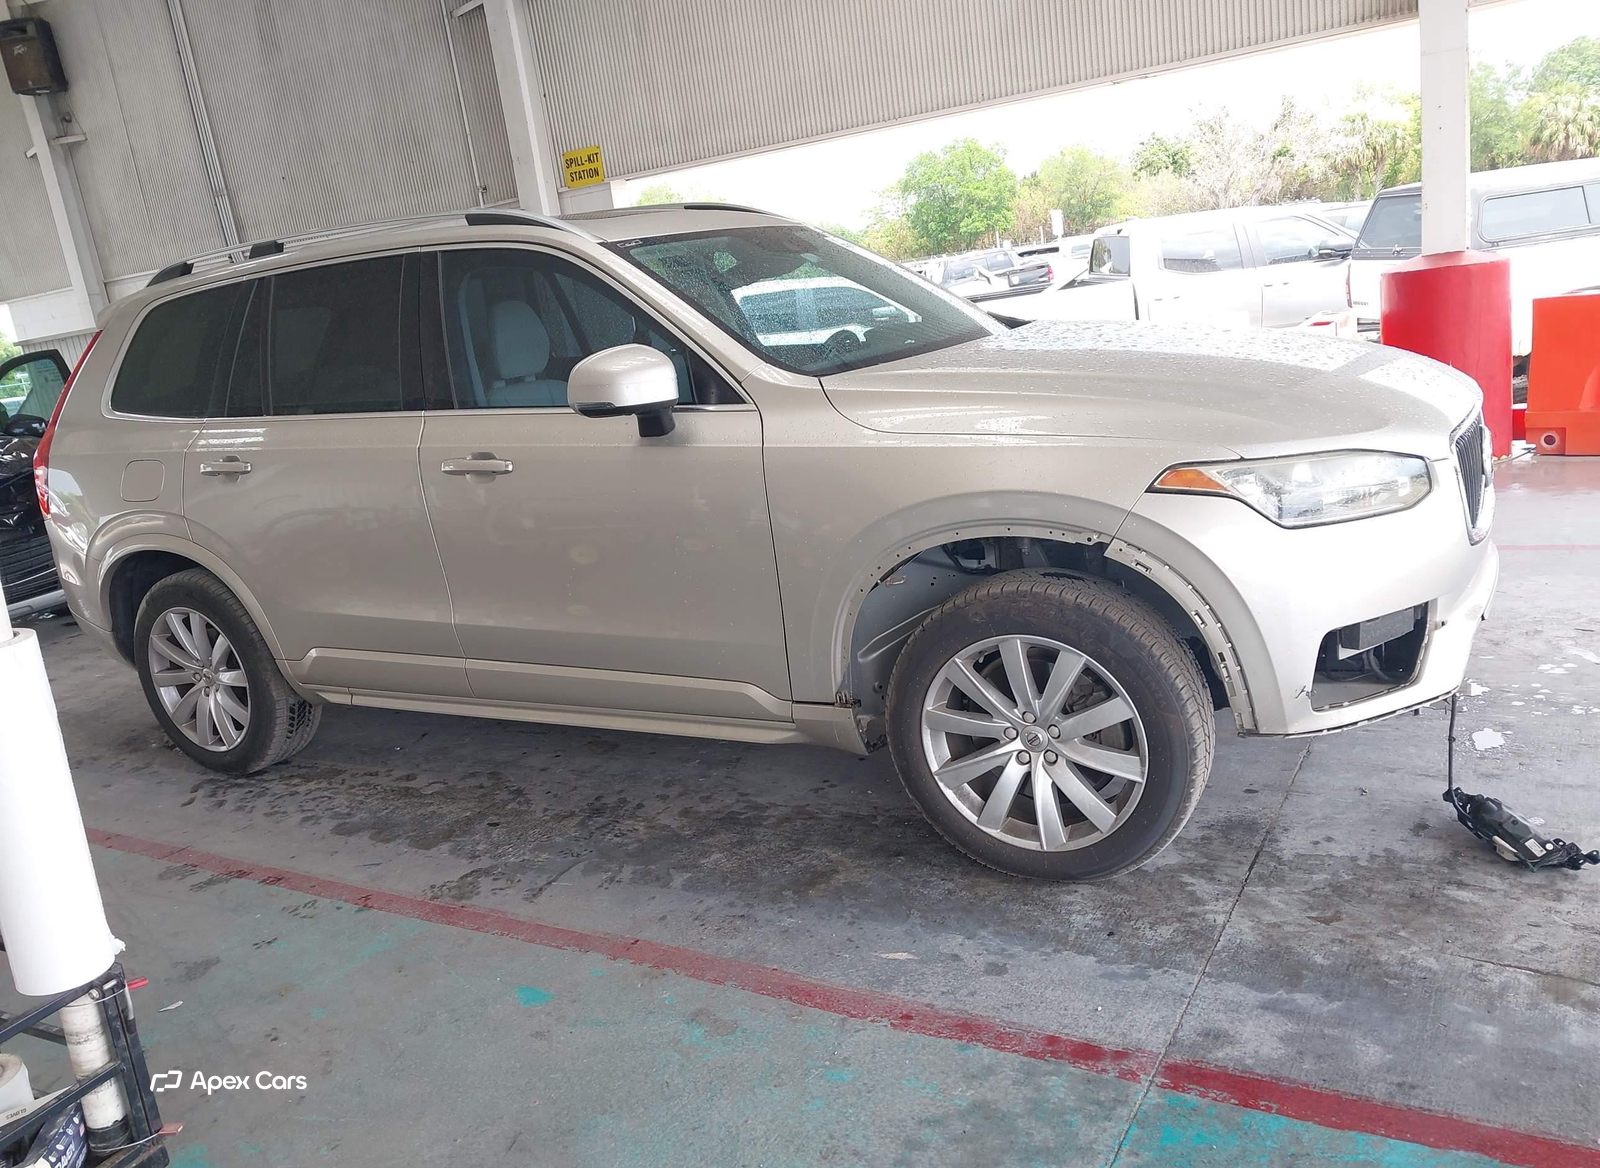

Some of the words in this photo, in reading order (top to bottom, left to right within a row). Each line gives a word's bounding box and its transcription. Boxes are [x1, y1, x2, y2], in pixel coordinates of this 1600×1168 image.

[565, 152, 599, 169] SPILL-KIT
[570, 167, 600, 183] STATION
[5, 1107, 27, 1120] GLOVES
